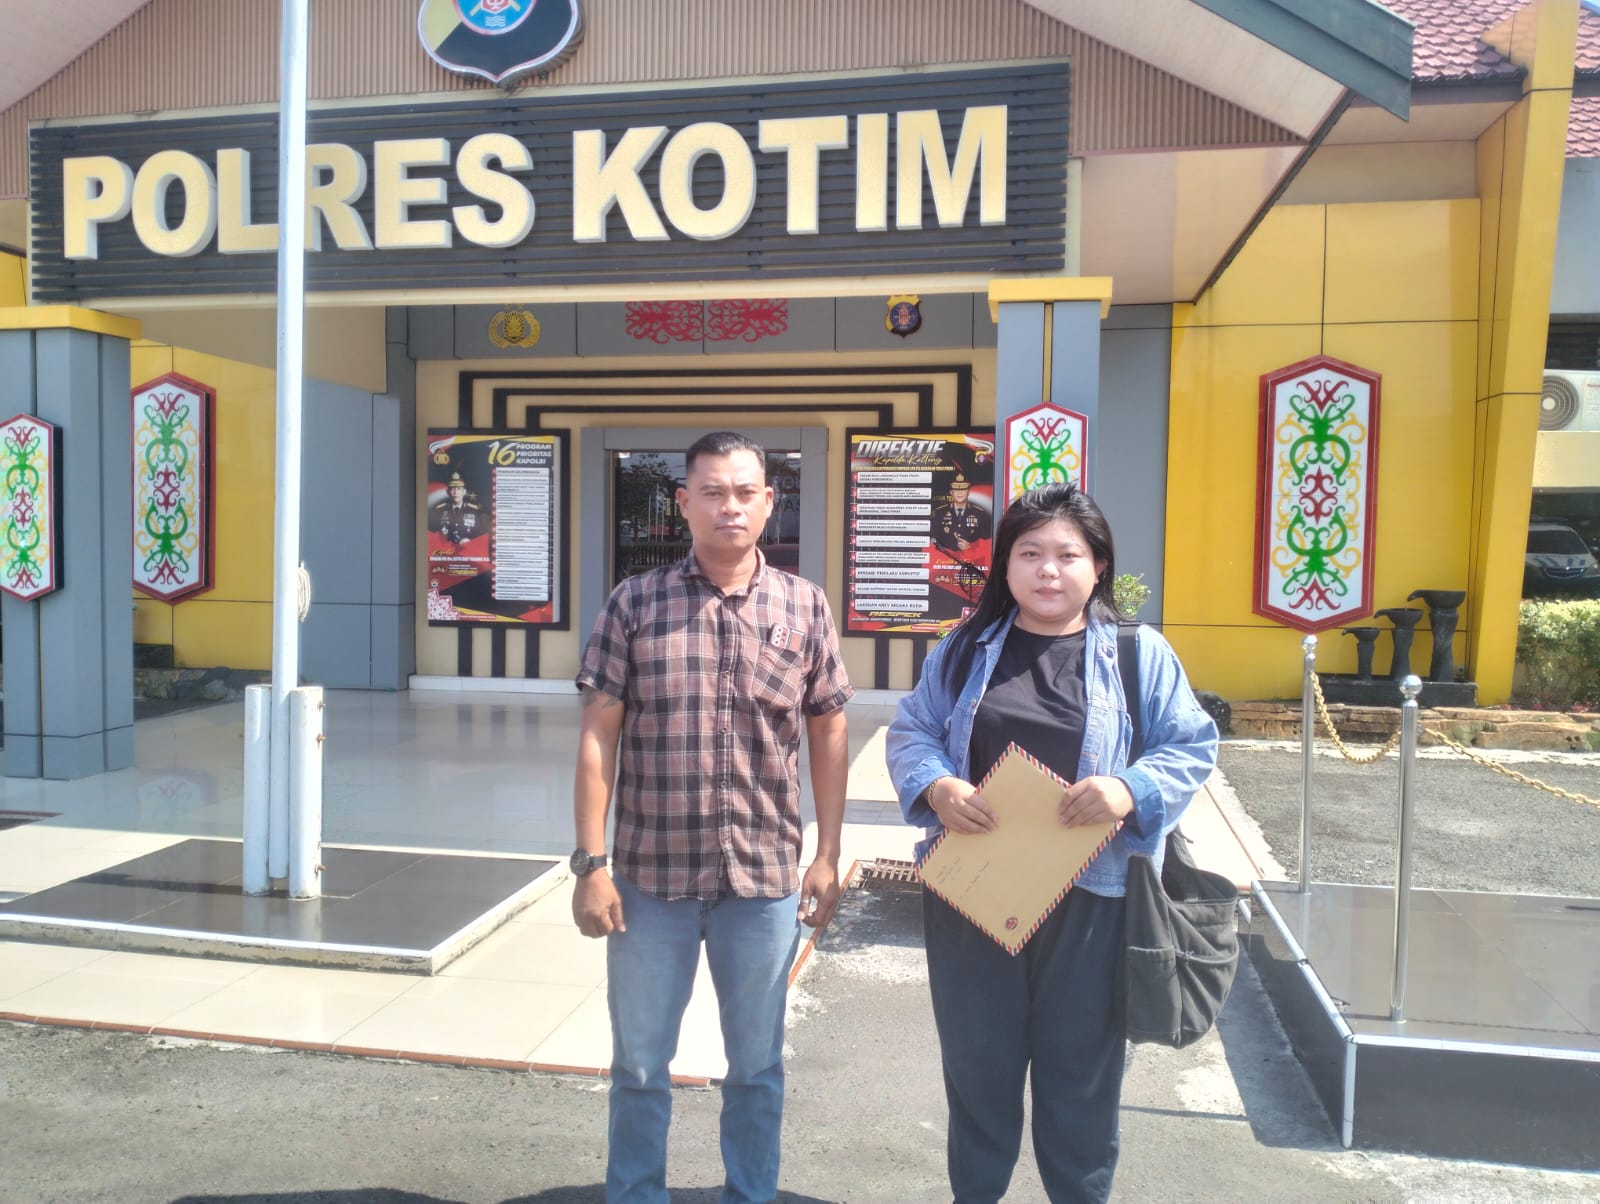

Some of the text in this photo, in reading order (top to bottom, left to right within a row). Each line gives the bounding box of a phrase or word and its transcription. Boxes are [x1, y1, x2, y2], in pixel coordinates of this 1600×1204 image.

[63, 104, 1008, 260] POLRES KOTIM
[488, 441, 517, 466] 16
[855, 440, 947, 459] DIREKTIF
